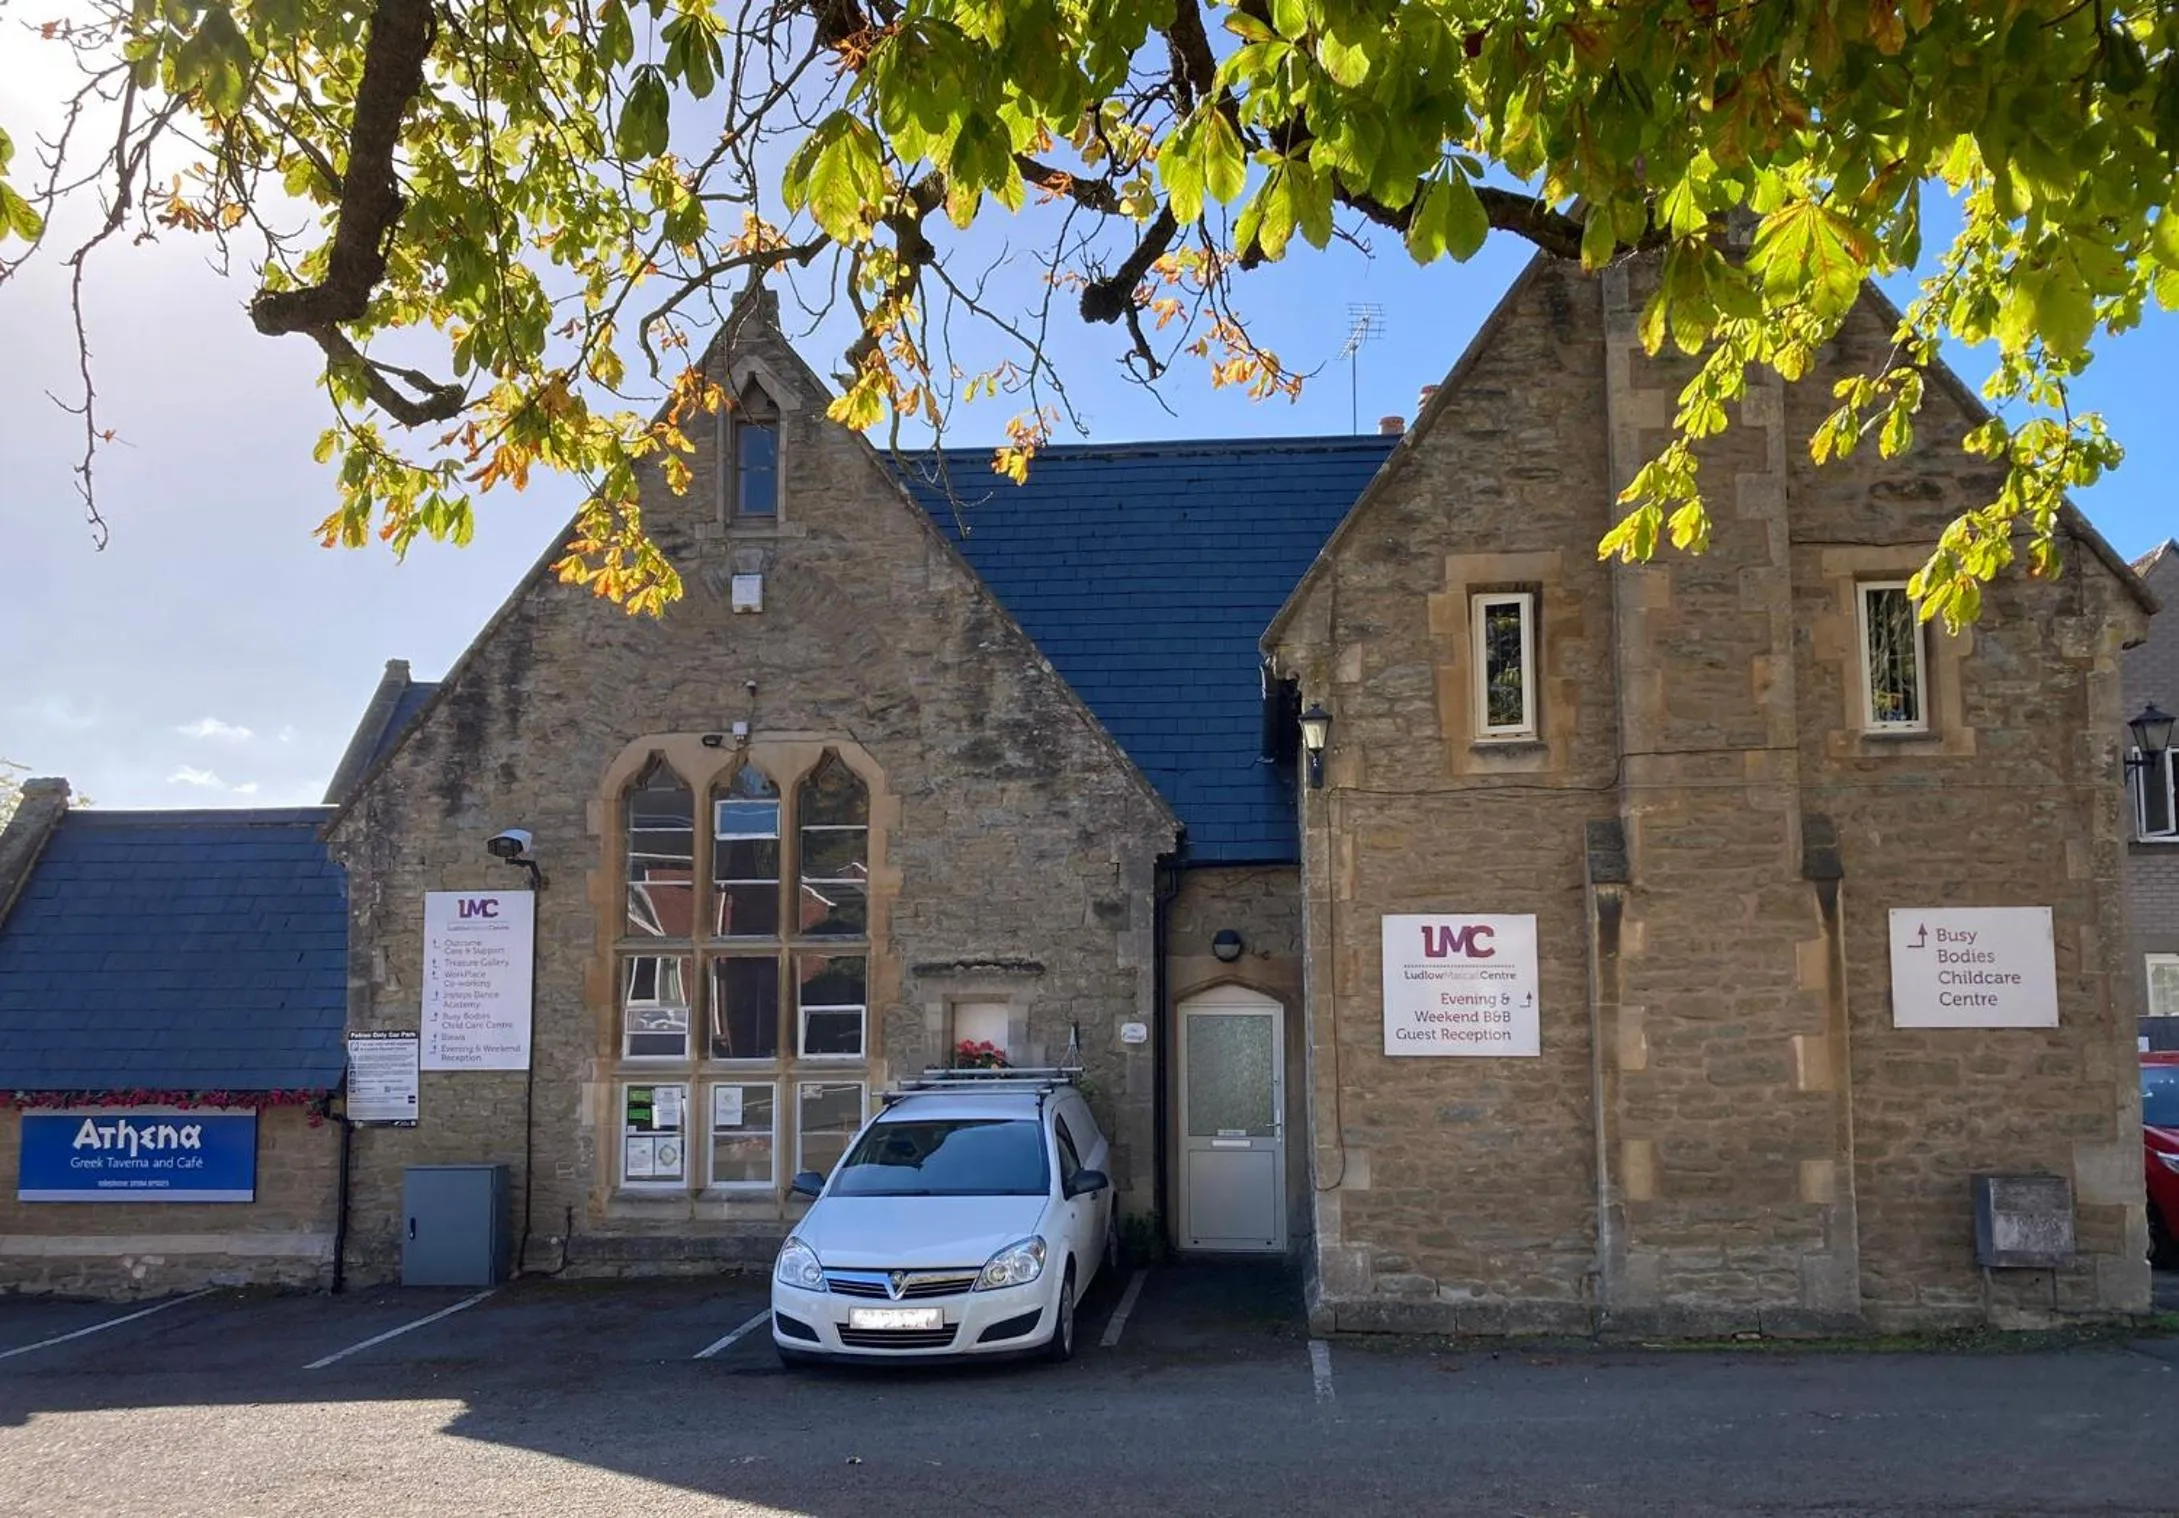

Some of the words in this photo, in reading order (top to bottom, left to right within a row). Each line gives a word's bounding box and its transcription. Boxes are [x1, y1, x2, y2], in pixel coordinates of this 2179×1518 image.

[457, 899, 499, 918] LMC
[1421, 925, 1496, 958] LMC
[1936, 928, 1978, 945] Busy
[444, 958, 478, 967] Treasure
[480, 958, 510, 969] Gallery
[1937, 949, 1996, 964] Bodies
[1938, 970, 2022, 985] Childcare
[1441, 993, 1497, 1008] Evening
[1500, 993, 1511, 1005] &
[1939, 991, 1999, 1006] Centre
[1415, 1010, 1479, 1023] Weekend
[1484, 1011, 1512, 1023] B&B
[1396, 1028, 1437, 1041] Guest
[1440, 1028, 1512, 1042] Reception
[441, 1044, 473, 1054] Evening
[483, 1044, 521, 1052] Weekend
[441, 1053, 482, 1063] Reception
[70, 1157, 103, 1168] Greek
[107, 1157, 149, 1168] Taverna
[152, 1157, 174, 1168] and
[176, 1156, 204, 1168] Café
